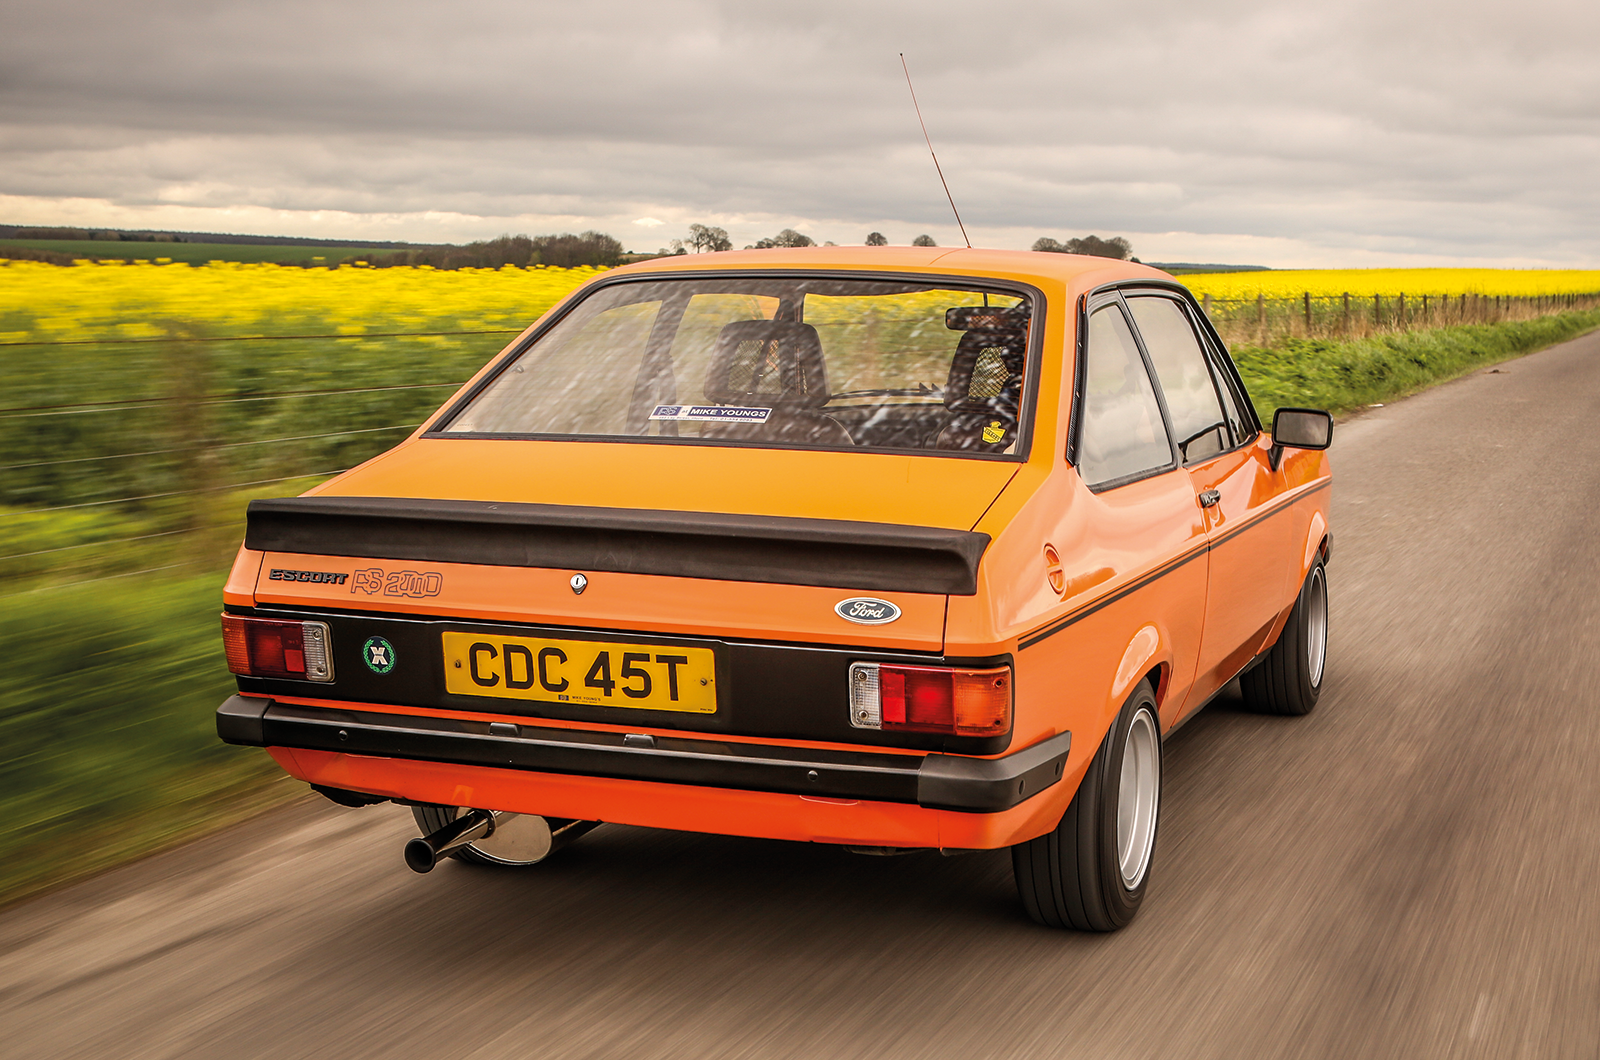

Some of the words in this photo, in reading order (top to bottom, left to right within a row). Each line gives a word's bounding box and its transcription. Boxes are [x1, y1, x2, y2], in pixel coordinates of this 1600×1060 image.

[690, 408, 718, 416] MIKE
[720, 409, 767, 418] YOUNGS
[269, 568, 349, 585] ESCORT
[350, 568, 384, 595] RS
[383, 569, 443, 598] 2000
[849, 601, 885, 619] Ford
[468, 642, 570, 693] CDC
[584, 650, 688, 702] 45T
